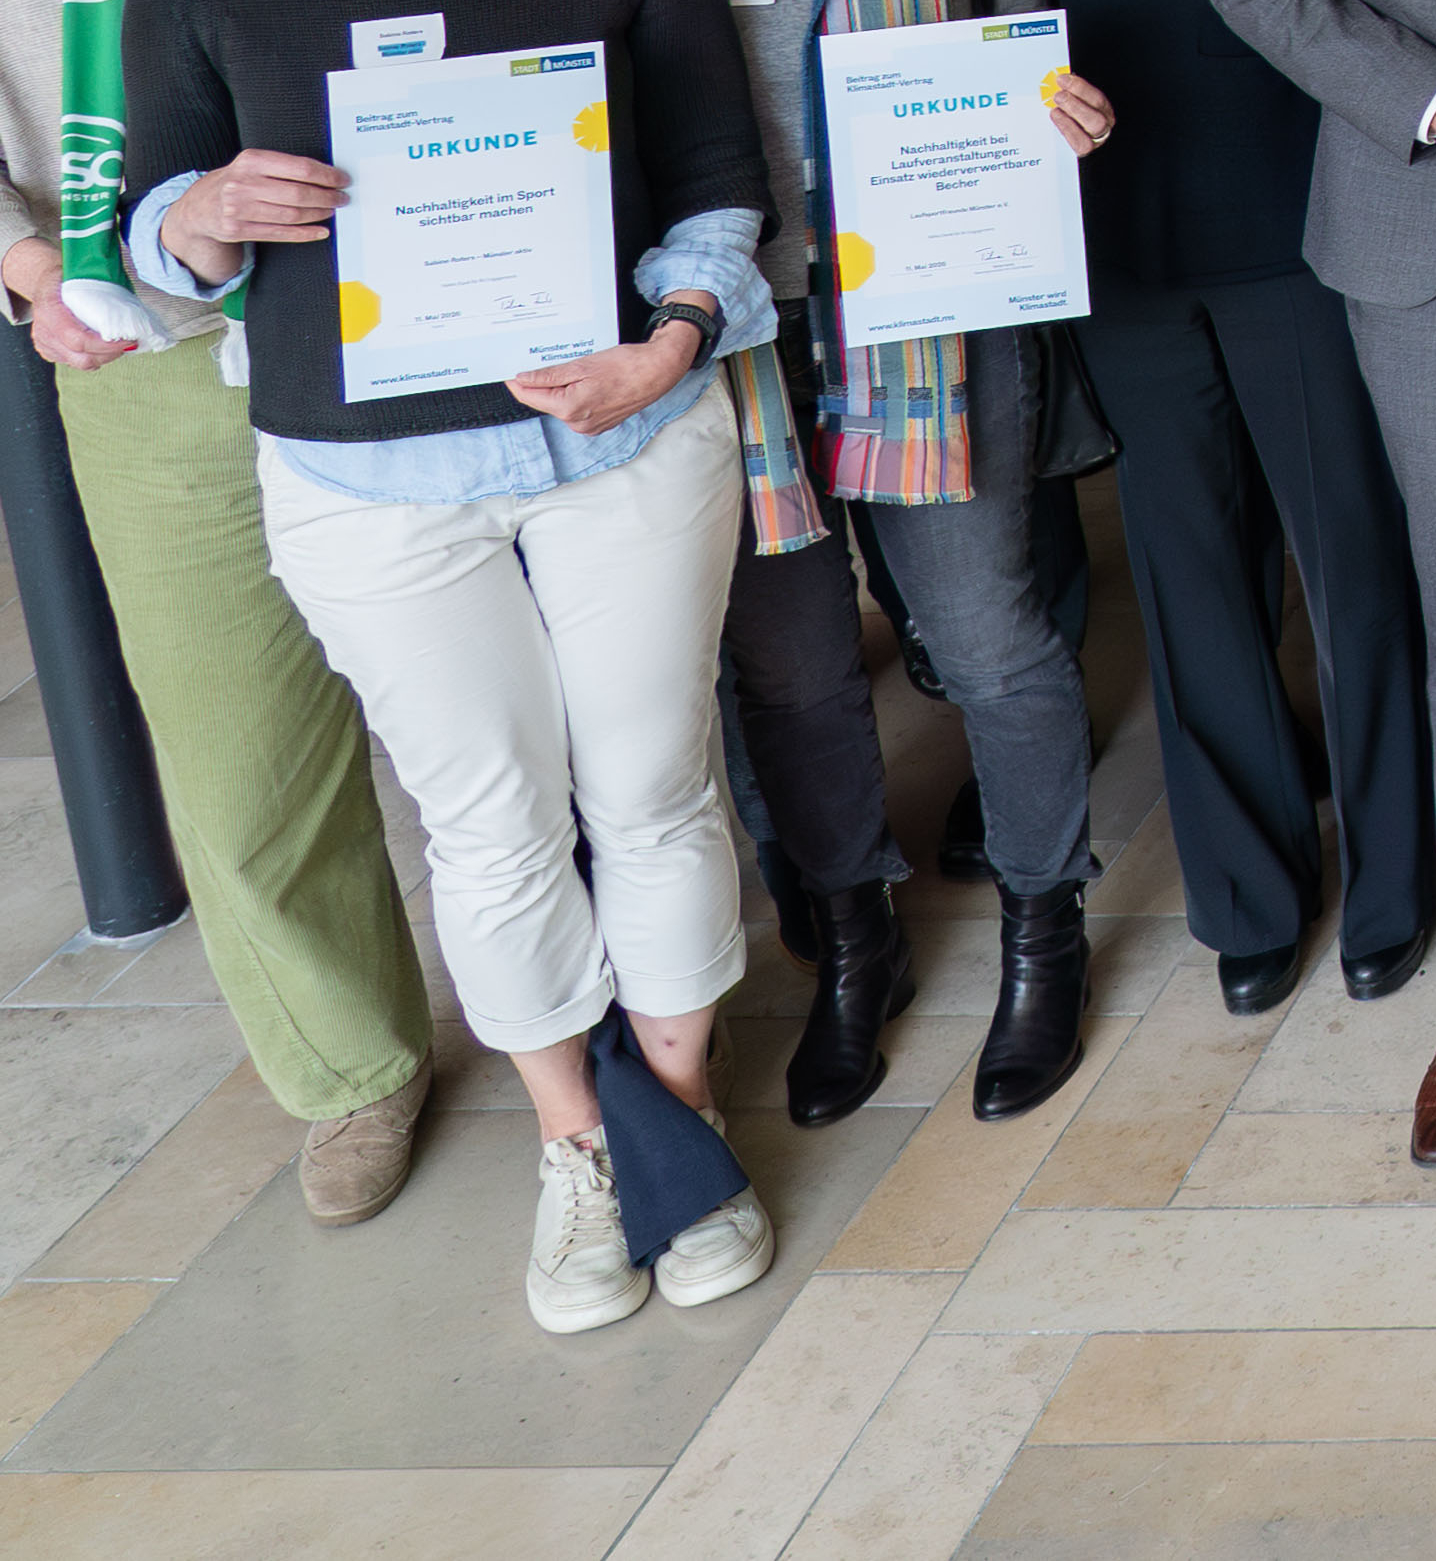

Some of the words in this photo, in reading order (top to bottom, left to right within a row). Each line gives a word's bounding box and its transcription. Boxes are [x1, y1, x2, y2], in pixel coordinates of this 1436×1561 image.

[1020, 25, 1056, 35] MÜNSTER
[553, 57, 593, 70] MÜNSTER
[846, 75, 879, 84] Beitrag
[847, 76, 933, 92] Klimastadt-Vertrag
[893, 92, 1009, 118] URKUNDE
[356, 111, 393, 124] Beitrag
[396, 111, 418, 120] zum
[356, 115, 454, 133] Klimastadt-Vertrag
[408, 130, 538, 159] URKUNDE
[900, 138, 988, 156] Nachhaltigkeit
[991, 134, 1009, 145] bei
[891, 147, 1020, 171] Laufveranstaltungen:
[61, 150, 124, 189] SC
[871, 173, 915, 186] Einsatz
[917, 157, 1041, 180] wiederverwertbarer
[936, 179, 979, 191] Becher
[61, 192, 110, 201] NSTER
[396, 194, 493, 216] Nachhaltigkeit
[497, 192, 514, 203] im
[517, 187, 555, 203] Sport
[419, 212, 475, 227] sichtbar
[479, 205, 533, 219] machen
[1009, 293, 1045, 304] Münster
[1049, 291, 1067, 299] wird
[868, 315, 956, 332] www.klimastadt.ms
[530, 342, 568, 354] Münster
[572, 339, 594, 349] wird
[370, 366, 468, 386] www.klimastadt.ms
